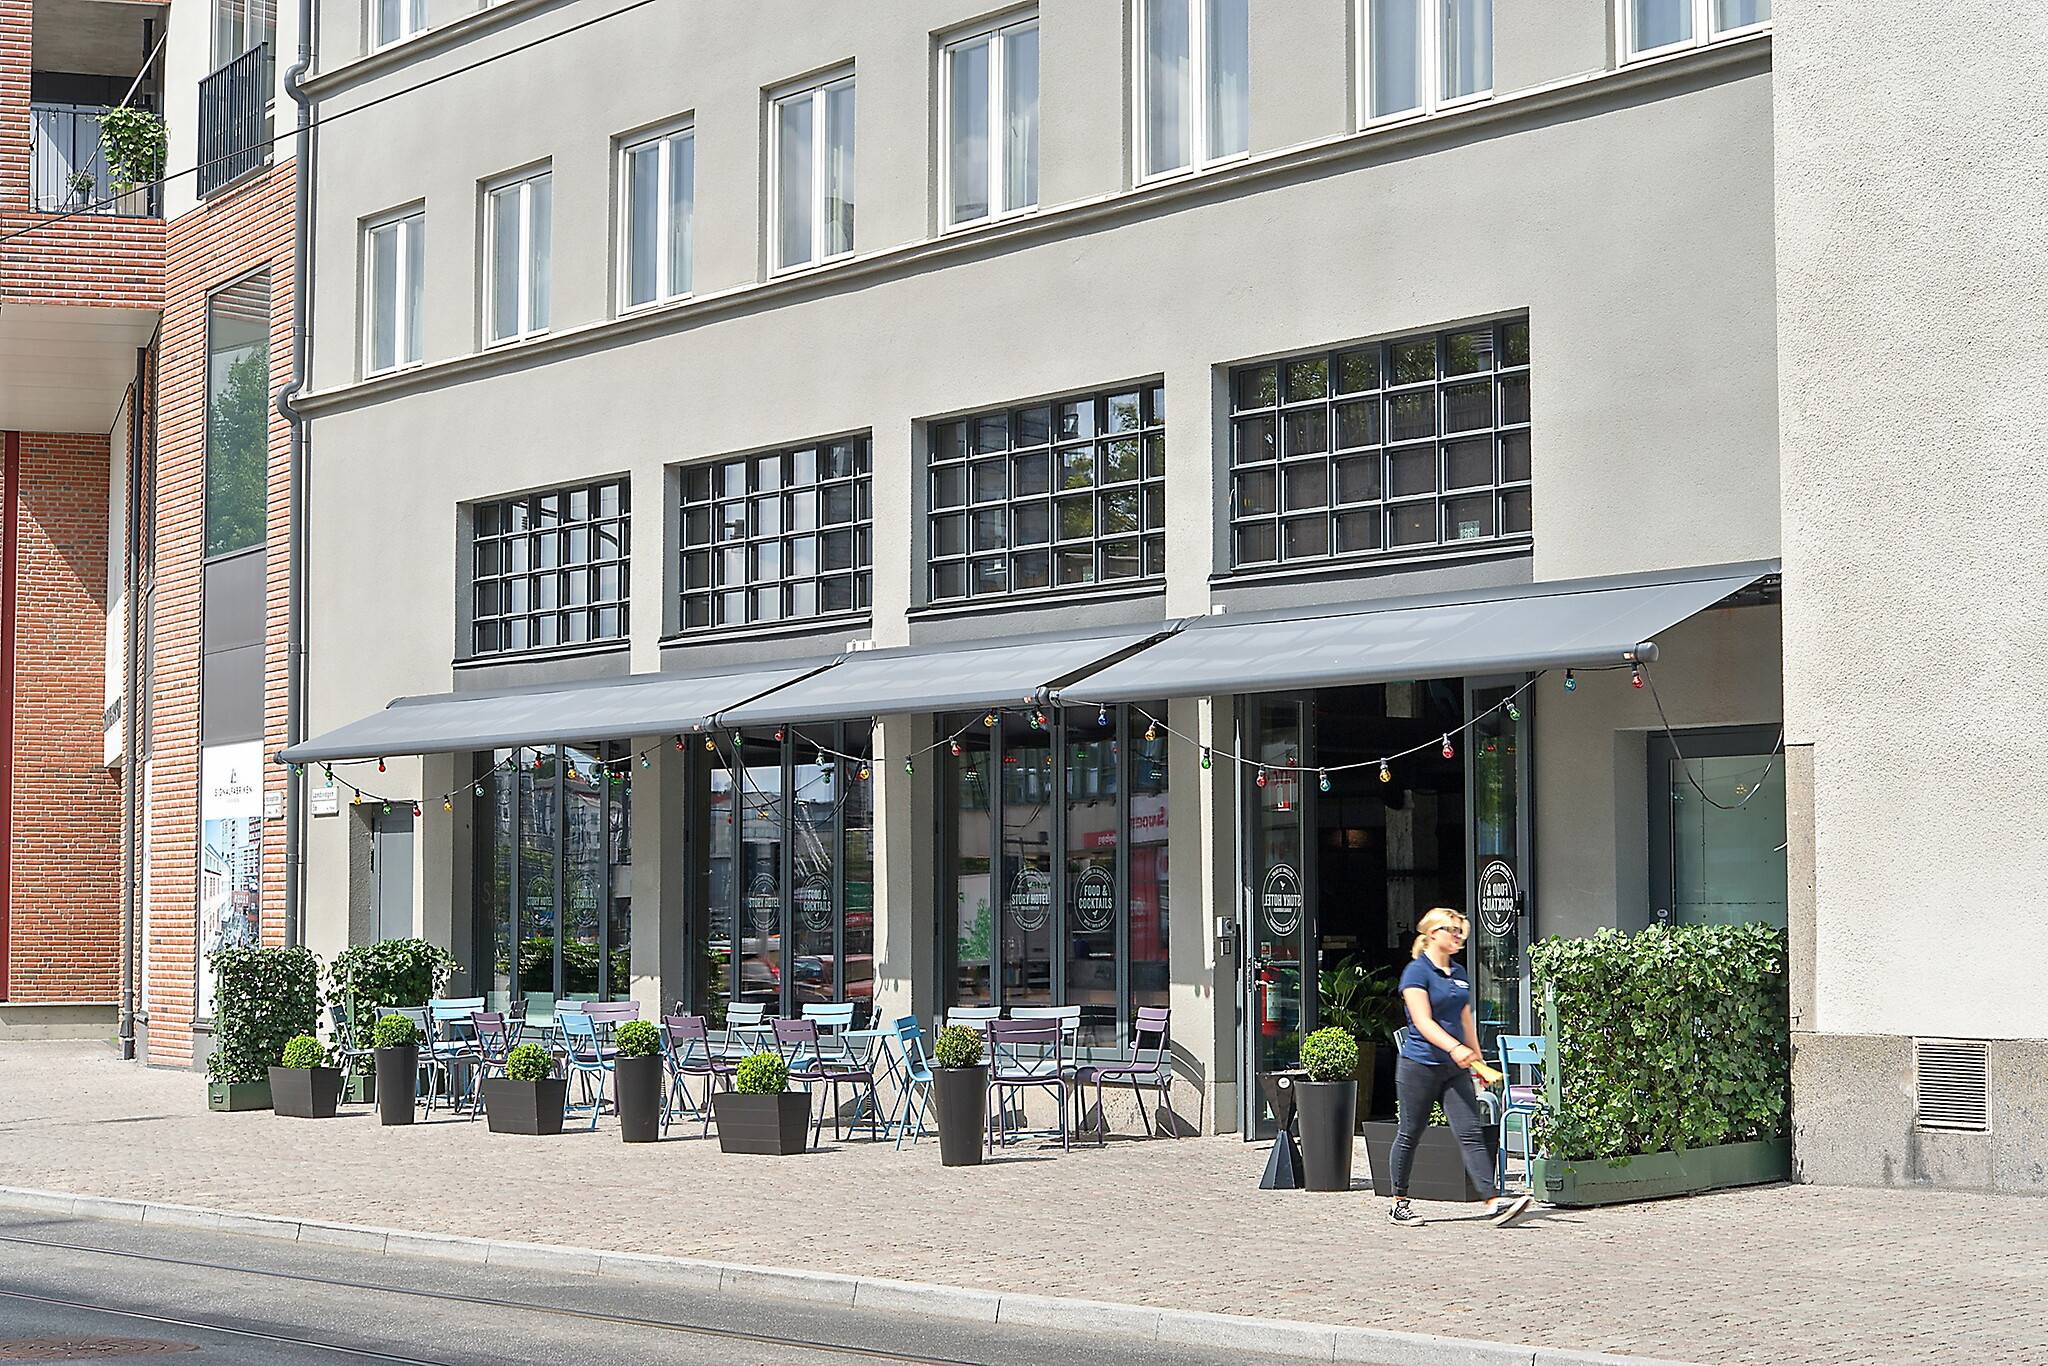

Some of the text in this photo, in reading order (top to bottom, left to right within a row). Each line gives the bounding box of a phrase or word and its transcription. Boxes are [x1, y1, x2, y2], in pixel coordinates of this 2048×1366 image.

[808, 889, 828, 900] FOOD &
[1084, 884, 1108, 896] FOOD &
[748, 897, 764, 908] STORY
[1011, 893, 1050, 905] STORY HOTEL
[1079, 897, 1113, 909] COCKTAILS
[803, 901, 832, 912] COCKTAILS
